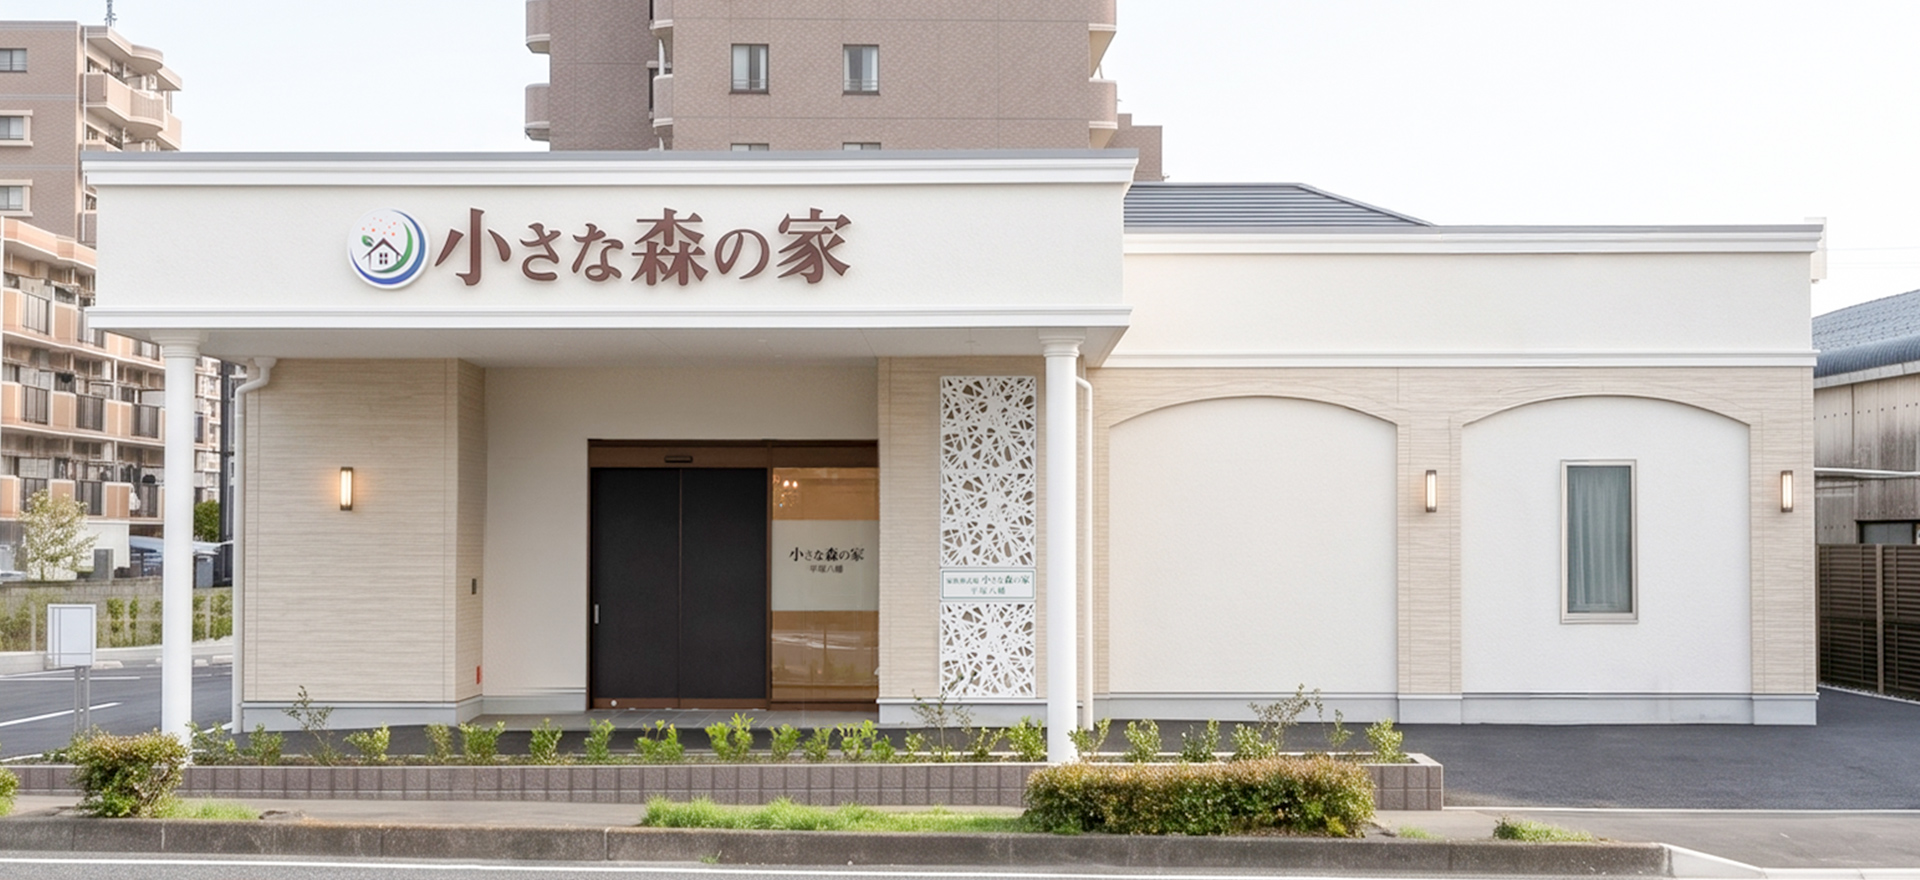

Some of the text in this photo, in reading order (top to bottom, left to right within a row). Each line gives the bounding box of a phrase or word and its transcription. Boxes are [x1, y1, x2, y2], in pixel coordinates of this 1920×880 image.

[434, 207, 852, 287] 小さな森の家
[789, 546, 865, 562] 小さな森の家
[981, 574, 1031, 585] 小さな森の家
